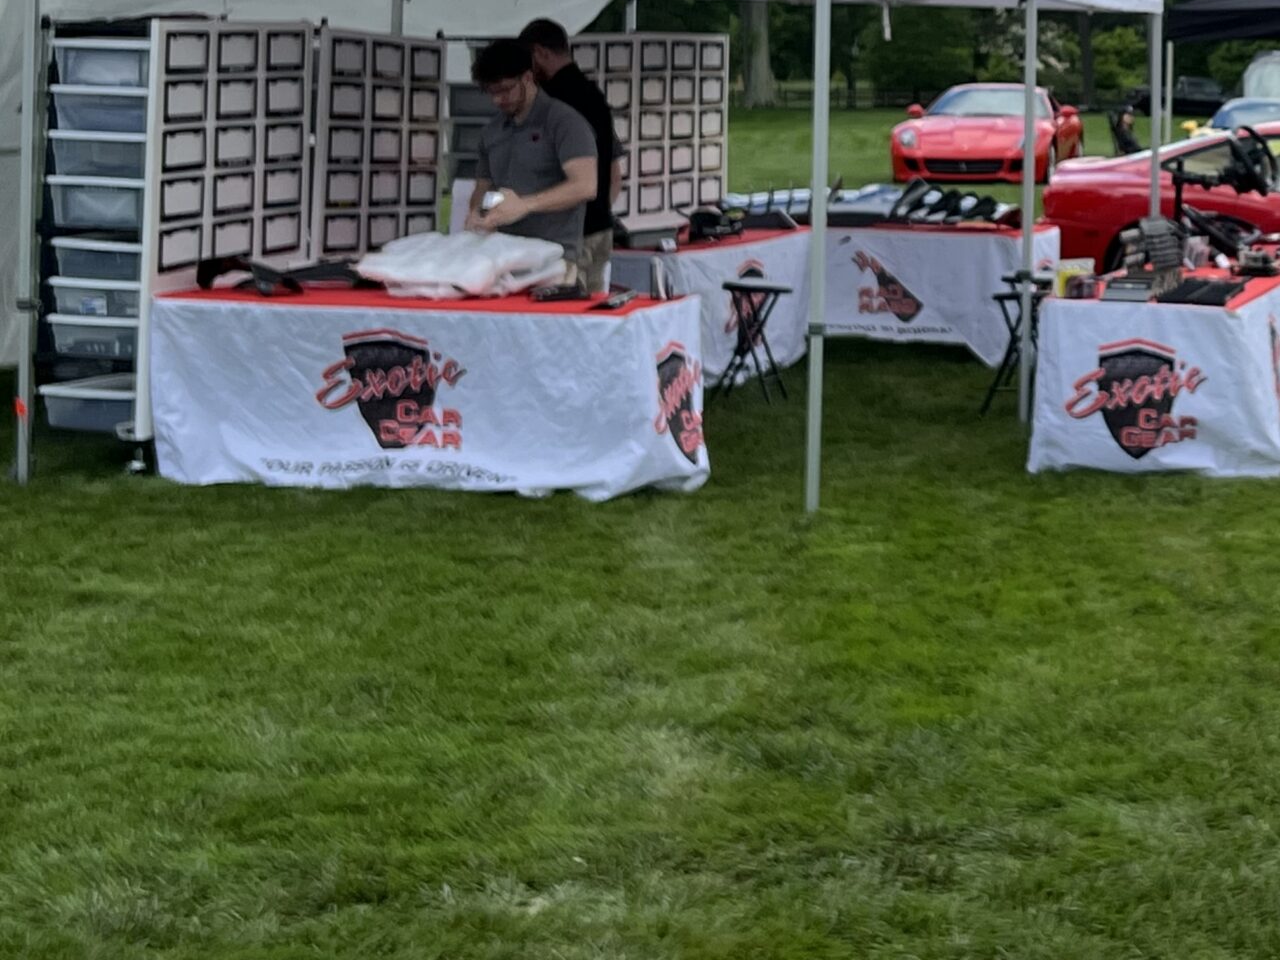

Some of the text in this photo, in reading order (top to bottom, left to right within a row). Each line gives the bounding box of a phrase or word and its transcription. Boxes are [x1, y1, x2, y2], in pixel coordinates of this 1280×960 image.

[315, 351, 468, 410] Exotic
[1064, 360, 1208, 419] Exotic
[396, 399, 462, 427] CAR
[1137, 408, 1198, 430] CAR
[1121, 425, 1198, 449] GEAR
